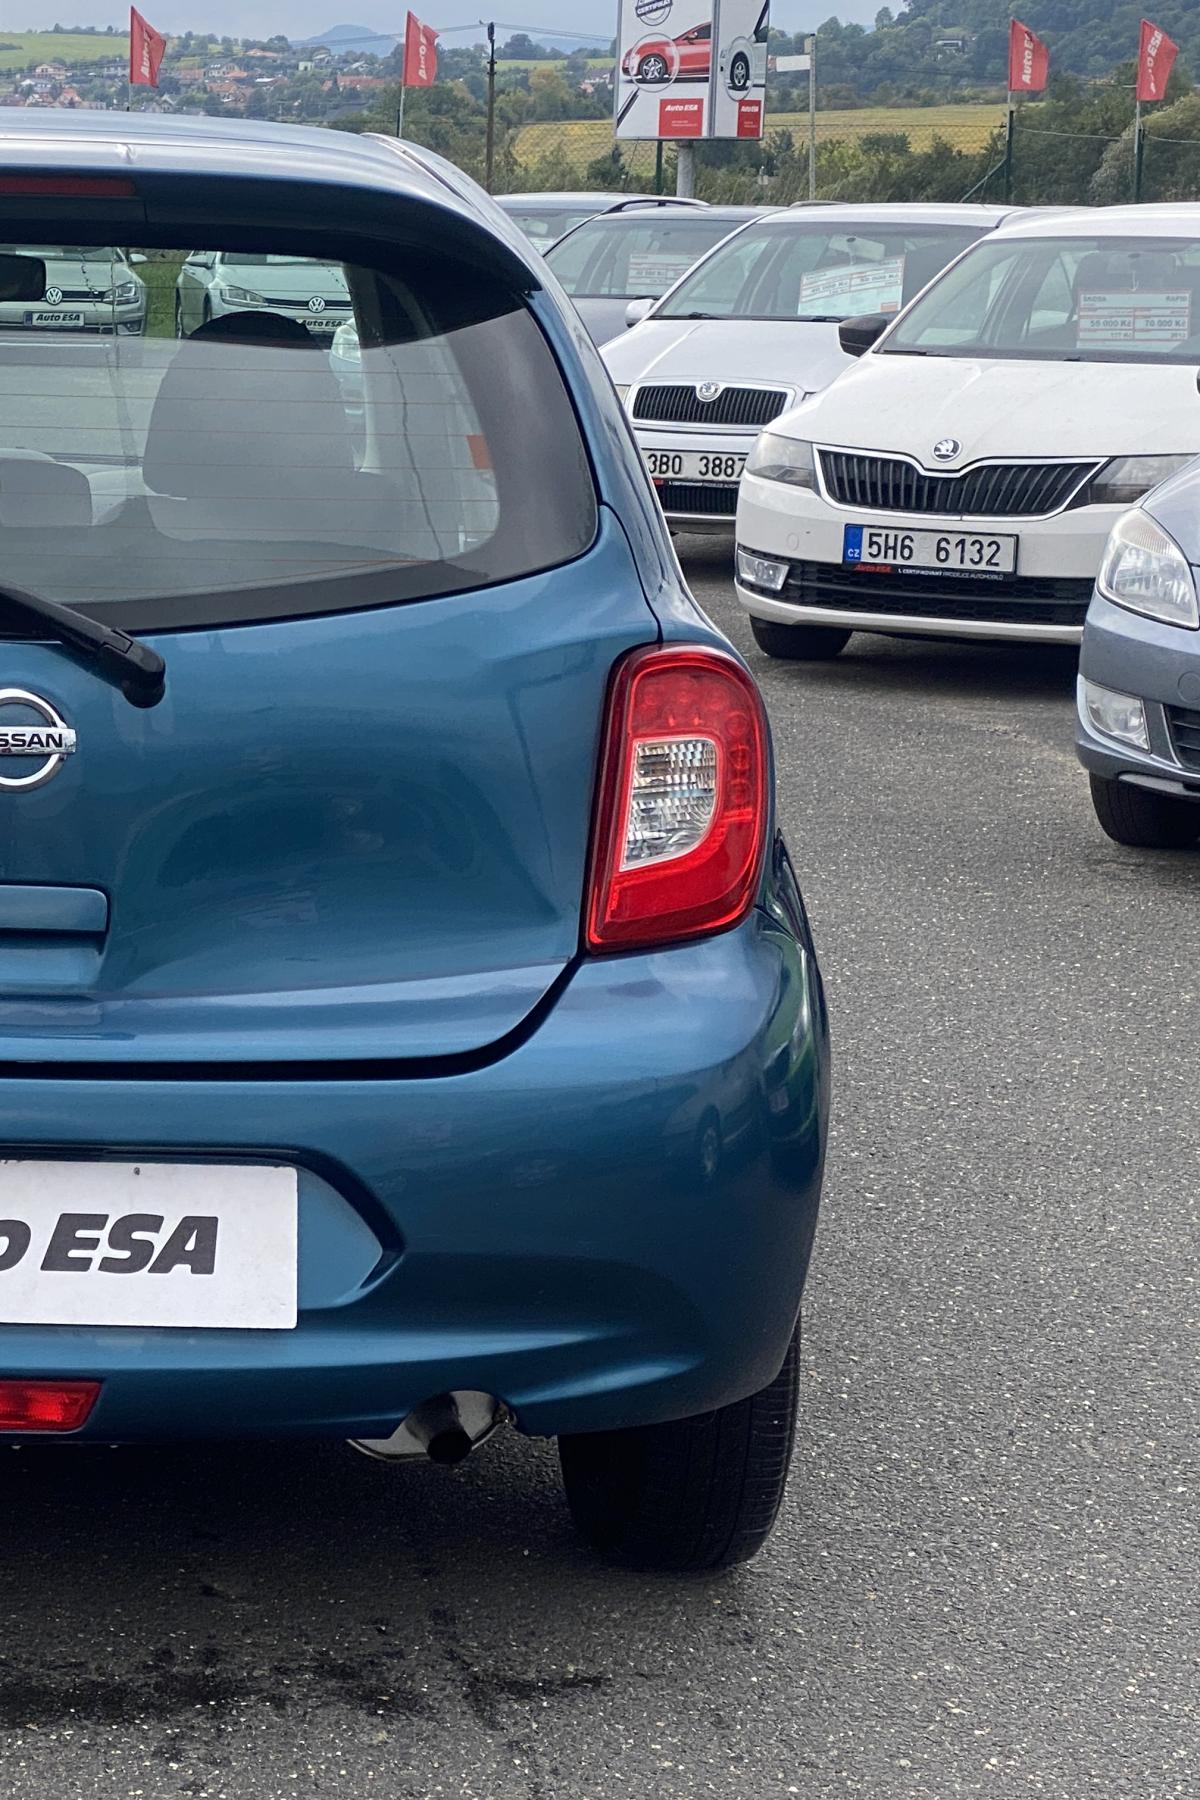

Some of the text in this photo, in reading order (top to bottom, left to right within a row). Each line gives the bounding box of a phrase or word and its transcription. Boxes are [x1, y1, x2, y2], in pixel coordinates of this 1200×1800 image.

[1021, 50, 1033, 85] Auto
[325, 320, 342, 328] ESA
[647, 453, 746, 478] 3B0 3887
[847, 548, 860, 558] CZ
[868, 533, 1000, 566] 5H6 6132
[40, 1213, 219, 1275] ESA
